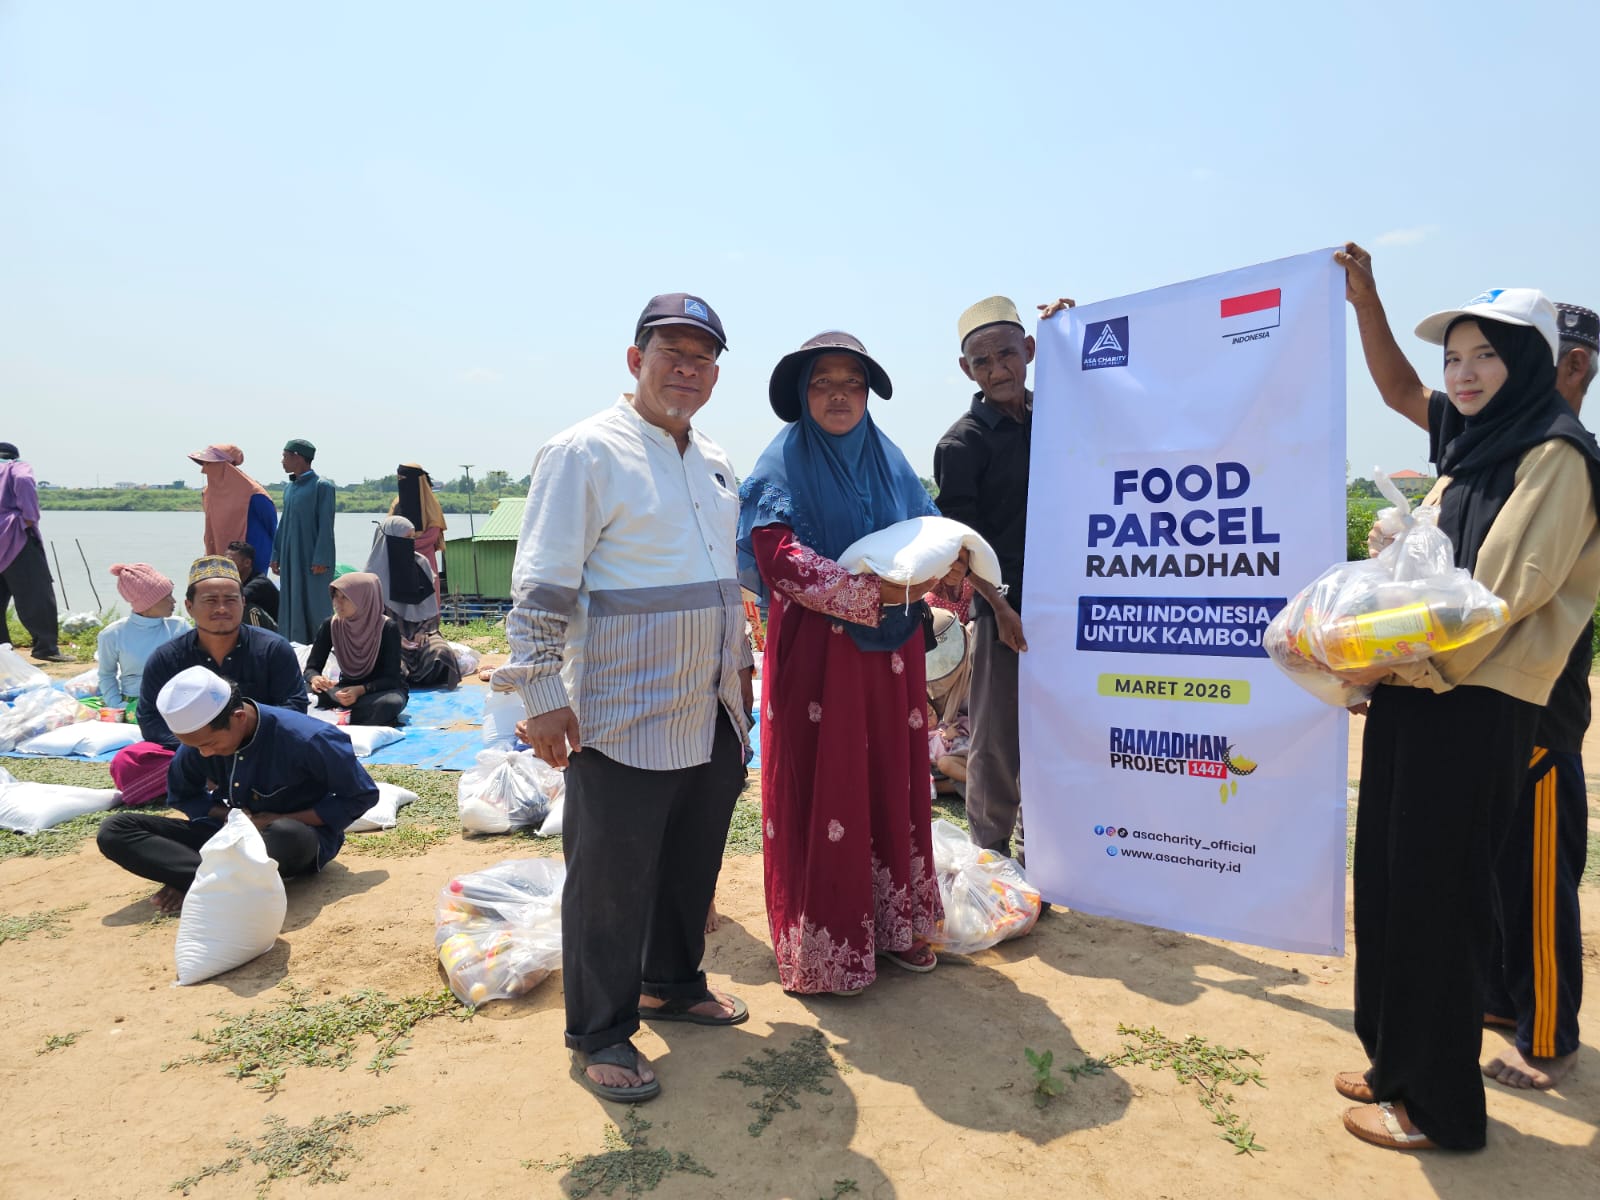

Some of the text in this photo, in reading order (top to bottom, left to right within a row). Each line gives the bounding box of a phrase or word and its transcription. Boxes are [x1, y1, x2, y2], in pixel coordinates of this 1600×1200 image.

[1232, 331, 1270, 344] INDONESIA
[1097, 355, 1126, 363] CHARITY
[1113, 461, 1251, 506] FOOD
[1087, 506, 1280, 548] PARCEL
[1085, 551, 1280, 578] RAMADHAN
[1091, 604, 1272, 625] DARI INDONESIA
[1083, 625, 1264, 647] UNTUK KAMBOJ
[1115, 678, 1232, 699] MARET 2026
[1110, 726, 1228, 762] RAMADHAN
[1110, 753, 1224, 777] PROJECT 1447
[1132, 829, 1256, 855] asacharity_official
[1120, 848, 1242, 874] www.asacharity.id
